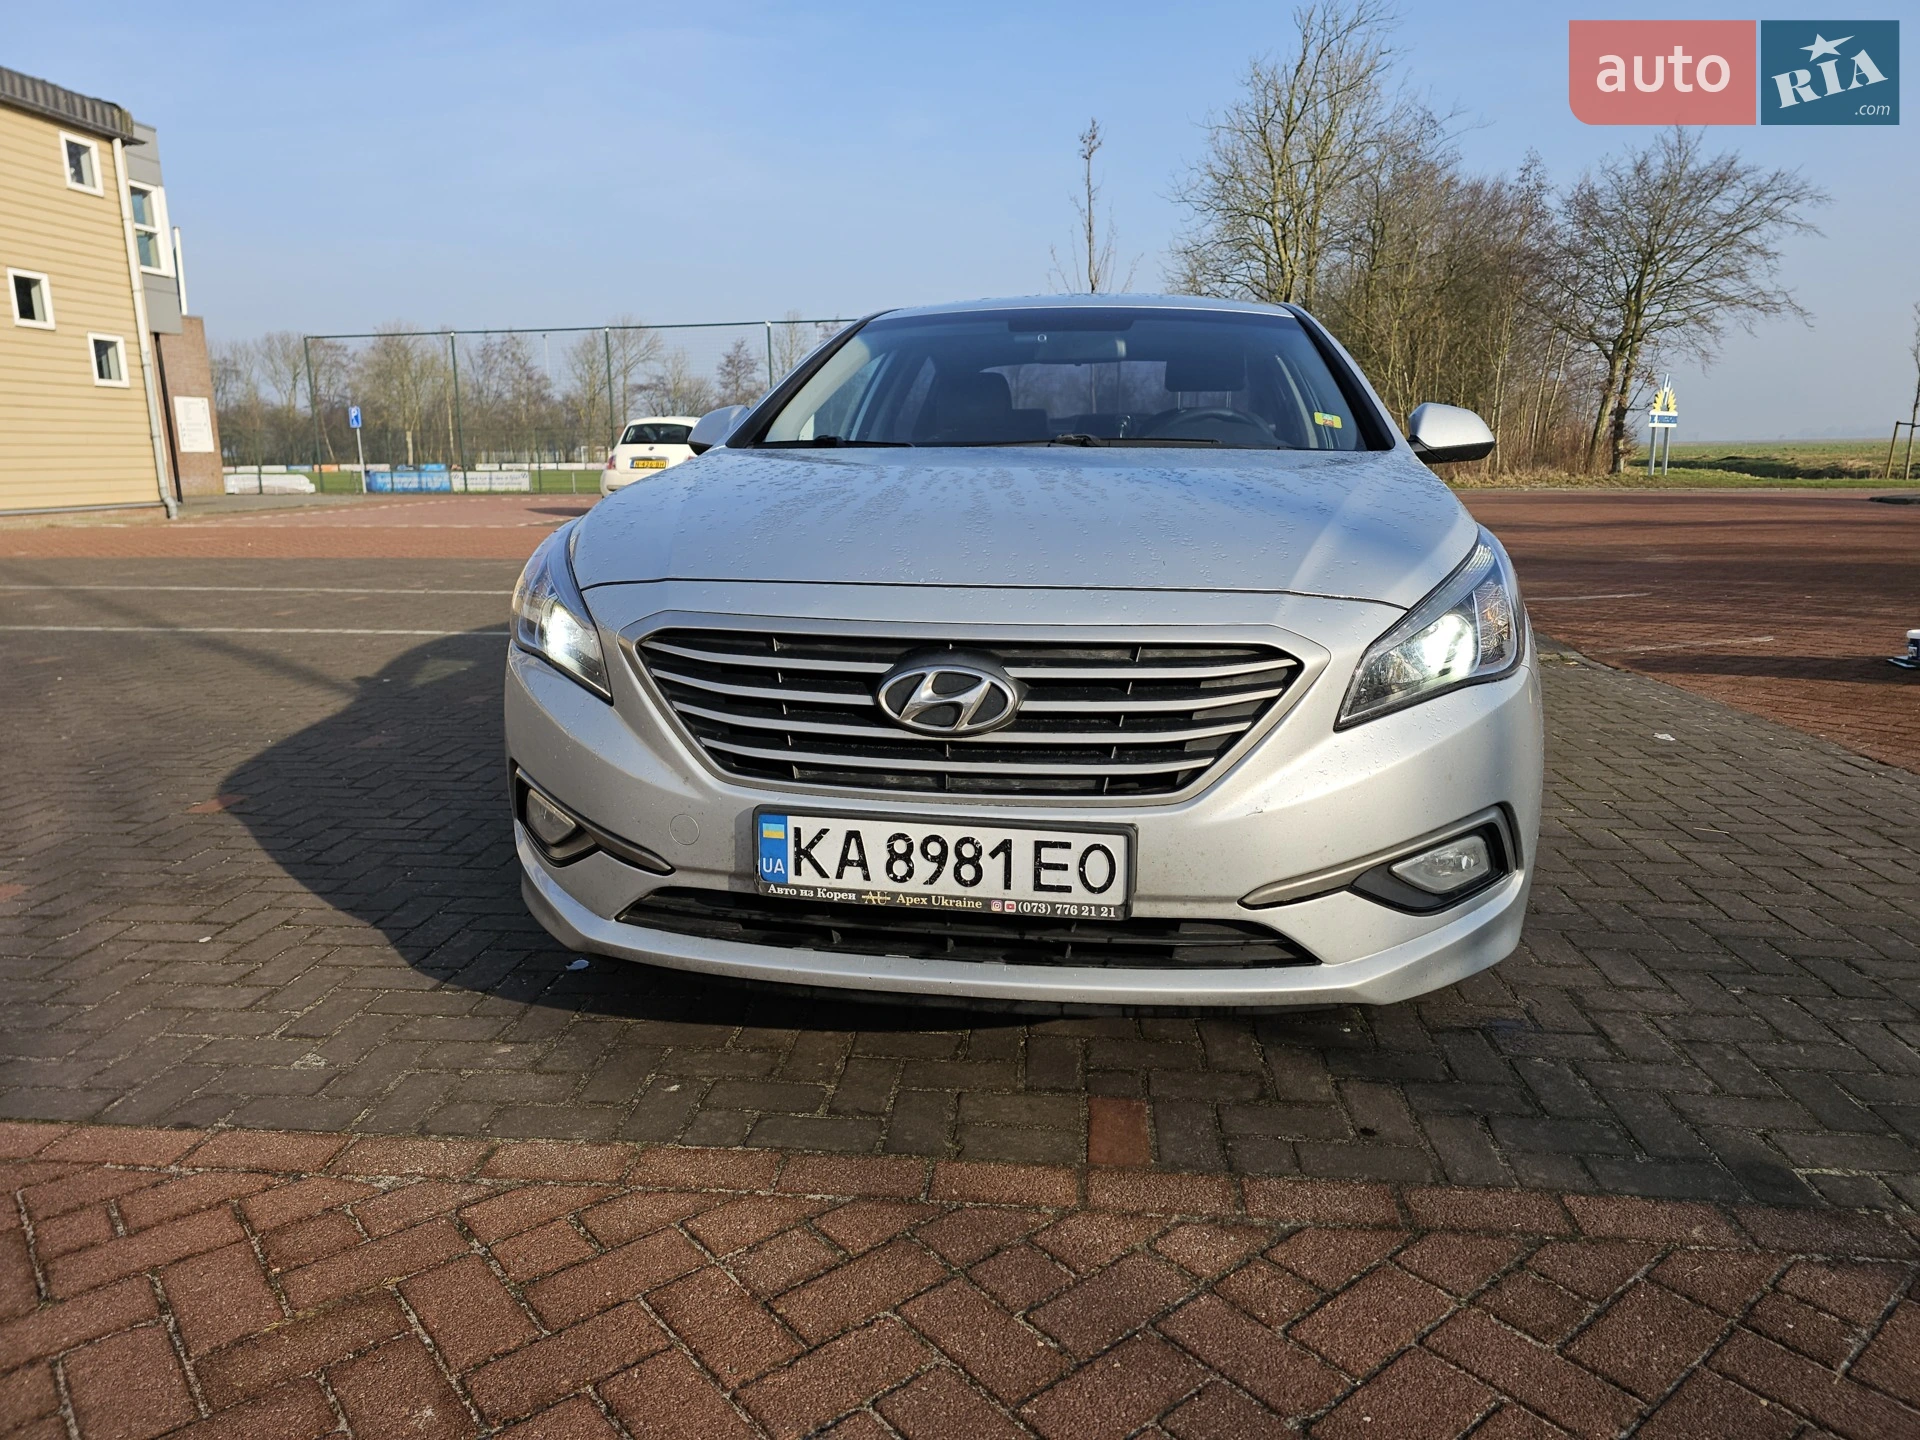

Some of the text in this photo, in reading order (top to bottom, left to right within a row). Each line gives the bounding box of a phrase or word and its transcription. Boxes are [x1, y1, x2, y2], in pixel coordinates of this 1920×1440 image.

[762, 856, 785, 875] UA
[793, 826, 1117, 896] KA 8981 EO
[767, 884, 856, 901] Авто из Кореи
[896, 893, 983, 909] Apex Ukraine
[1018, 901, 1116, 918] (073) 776 21 21
